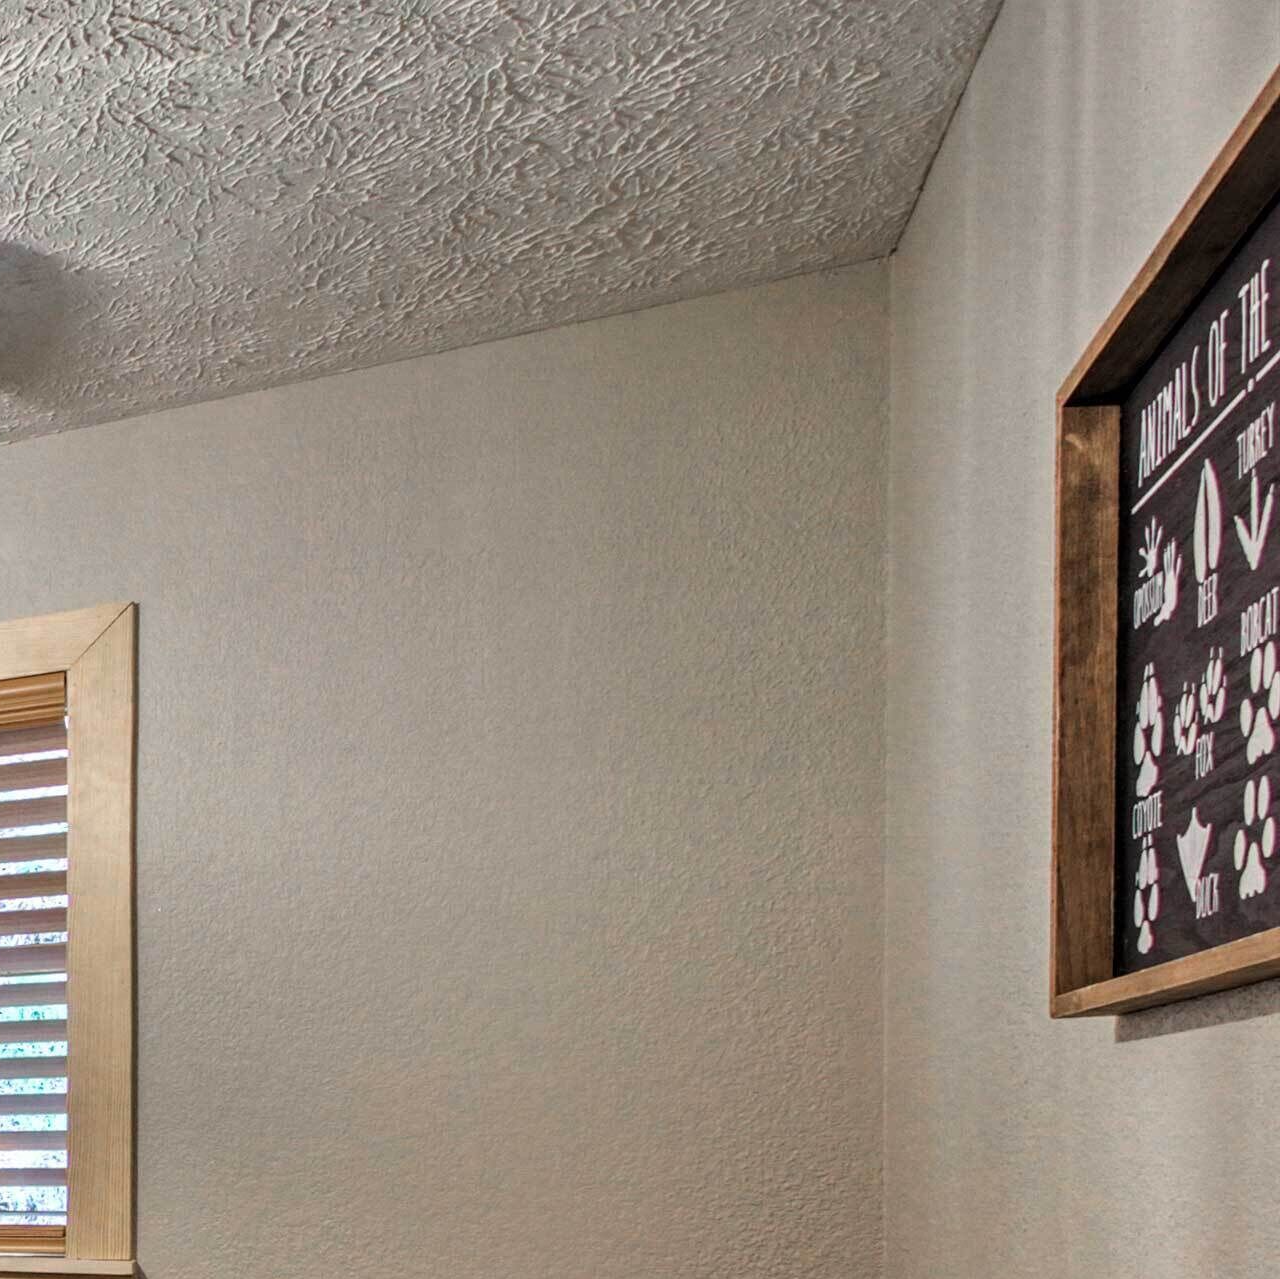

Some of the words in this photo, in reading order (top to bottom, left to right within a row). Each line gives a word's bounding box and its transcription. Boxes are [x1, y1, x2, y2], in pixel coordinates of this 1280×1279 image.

[1138, 345, 1200, 488] ANIMALS
[1208, 309, 1229, 407] OF
[1237, 258, 1272, 374] THE
[1236, 401, 1276, 480] TURKEY
[1240, 585, 1280, 658] BOBCAT
[1195, 731, 1214, 780] FOX
[1132, 790, 1163, 840] COYOTE
[1195, 872, 1220, 920] DUCK
